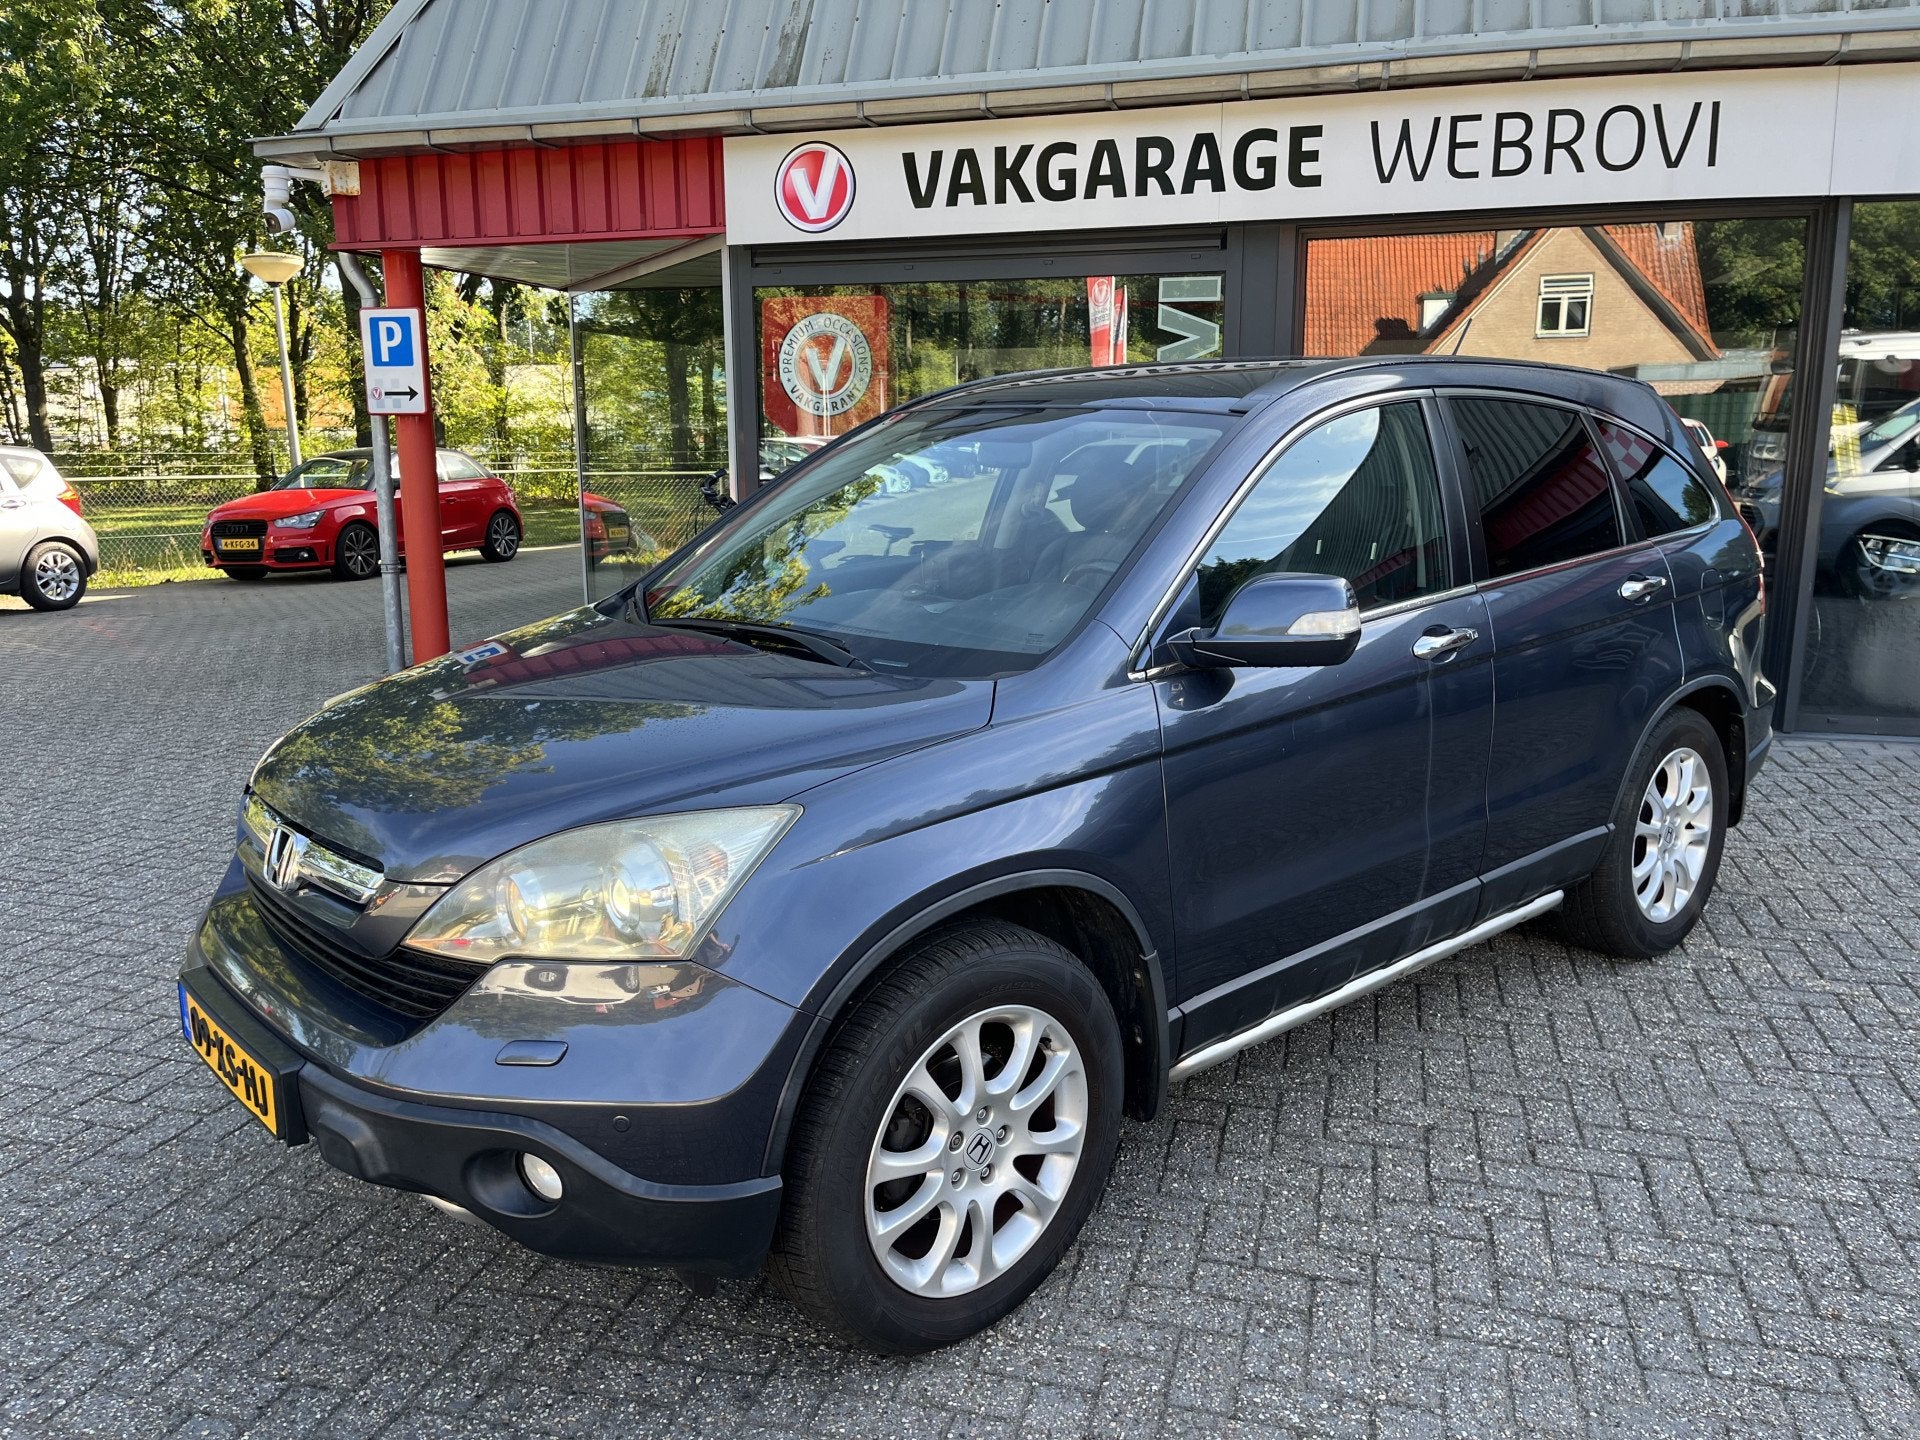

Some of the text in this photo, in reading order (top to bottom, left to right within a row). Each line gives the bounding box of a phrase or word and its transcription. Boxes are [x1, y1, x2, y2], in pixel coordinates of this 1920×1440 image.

[902, 100, 1721, 209] VAKGARAGE WEBROVI
[378, 320, 403, 362] P
[782, 317, 869, 374] PREMIUM OCCASIONS
[790, 384, 862, 412] VAKGARANT
[223, 539, 256, 549] 4-KFG-34
